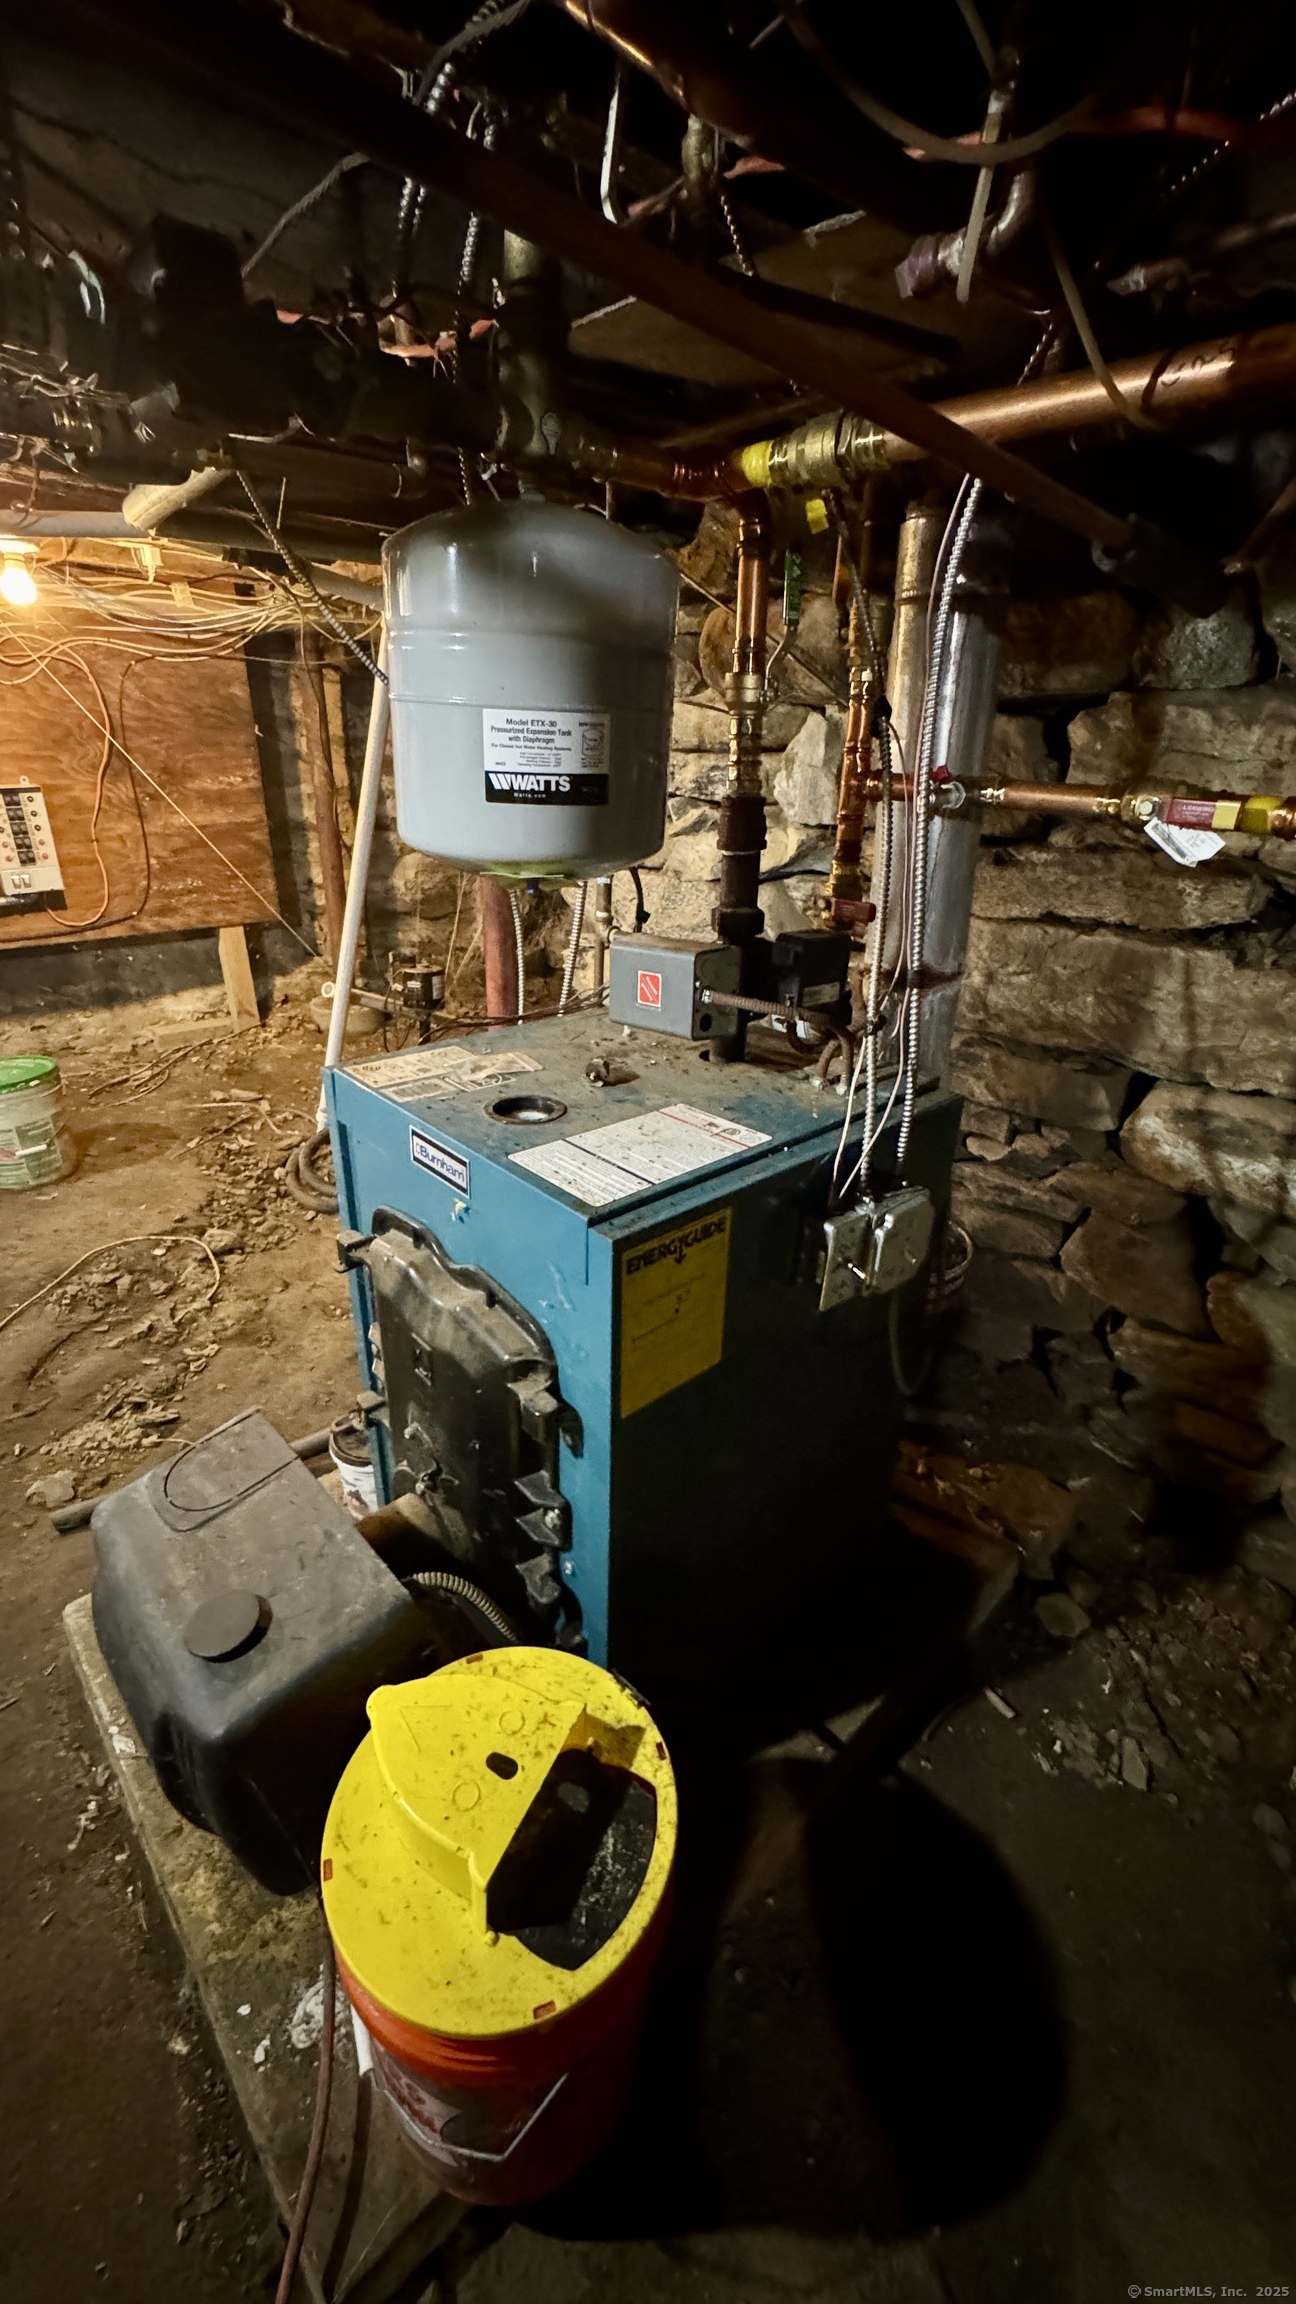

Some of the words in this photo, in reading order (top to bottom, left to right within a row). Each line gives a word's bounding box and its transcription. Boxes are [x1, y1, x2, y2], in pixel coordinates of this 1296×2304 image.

[506, 718, 528, 726] Model
[531, 719, 557, 727] ETX-30
[491, 725, 525, 734] Pressurized
[526, 728, 556, 736] Expansion
[558, 729, 572, 737] Tank
[522, 735, 555, 745] Diaphragm
[510, 774, 571, 792] WATTS
[420, 1145, 465, 1182] Burnham
[626, 1215, 726, 1276] ENERGYGUIDE
